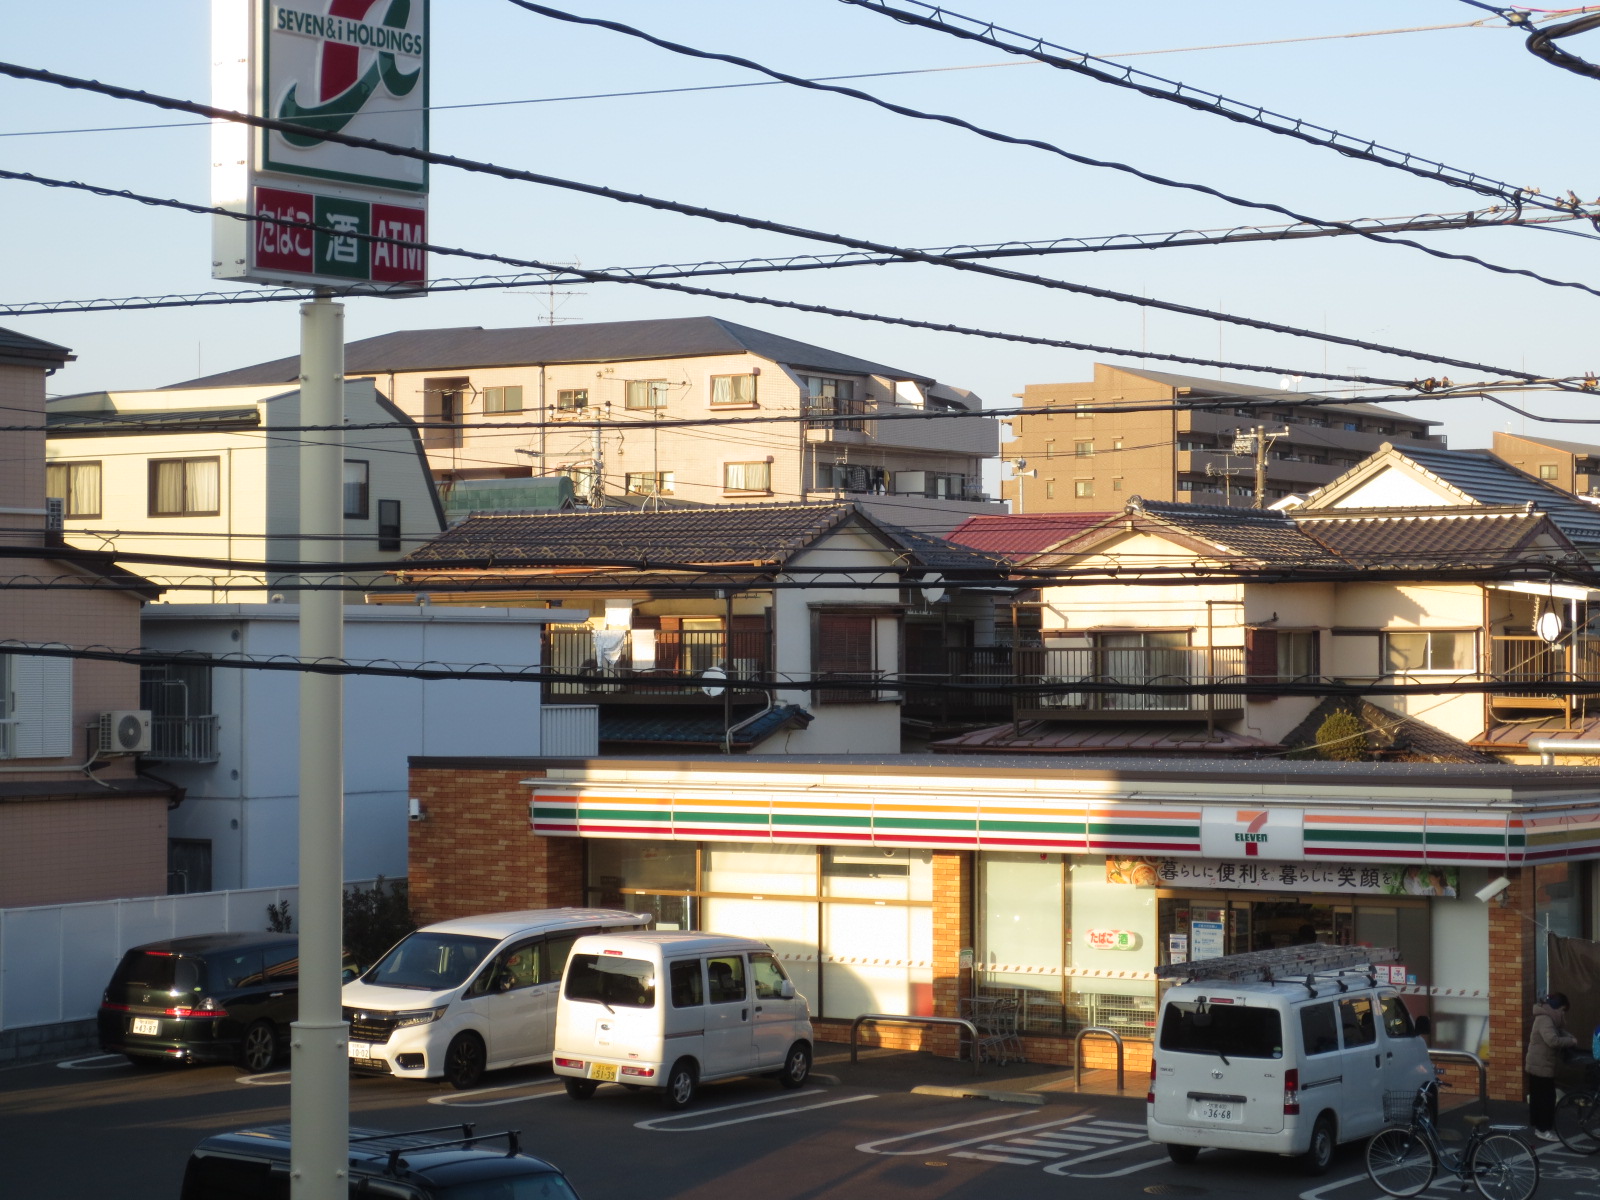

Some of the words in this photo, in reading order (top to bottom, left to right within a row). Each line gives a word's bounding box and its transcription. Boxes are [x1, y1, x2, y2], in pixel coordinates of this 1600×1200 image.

[347, 21, 422, 55] HOLDINGS
[258, 204, 311, 257] たばこ
[325, 212, 360, 264] 酒
[374, 219, 422, 271] ATM
[1090, 932, 1114, 944] たばこ
